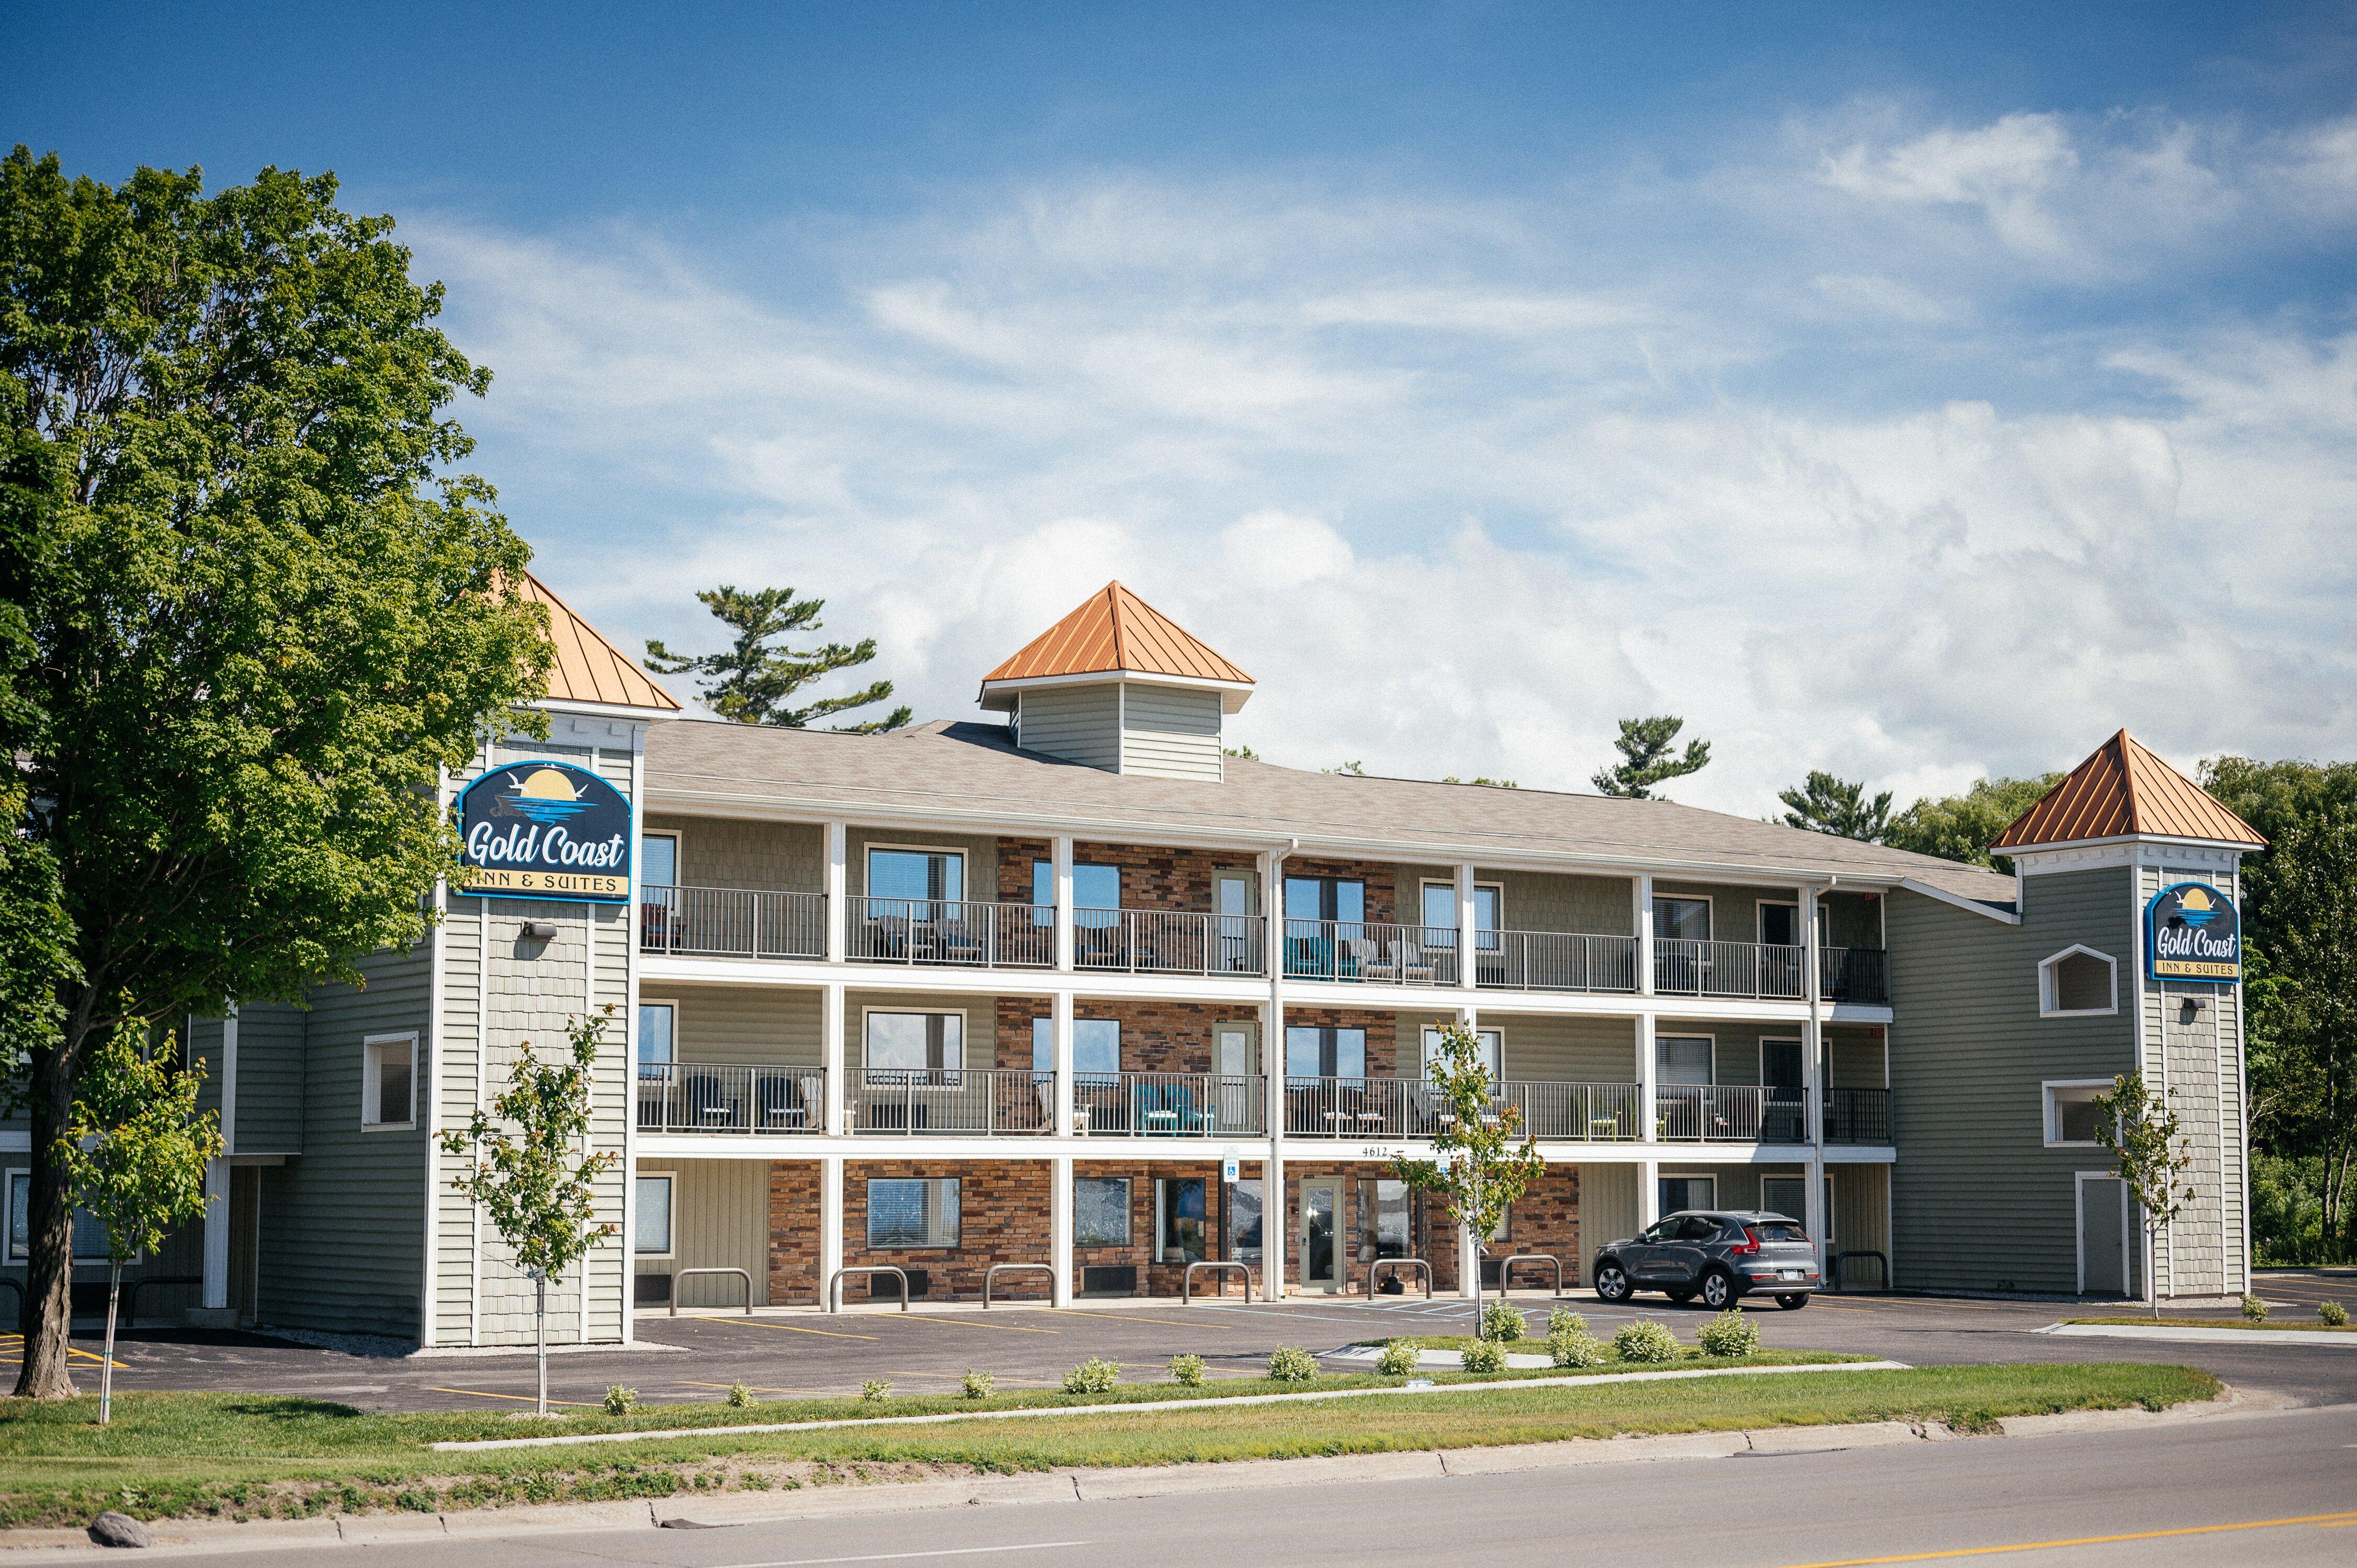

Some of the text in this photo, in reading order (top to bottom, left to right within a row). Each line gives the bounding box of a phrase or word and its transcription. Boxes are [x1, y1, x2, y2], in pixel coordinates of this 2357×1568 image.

[468, 821, 625, 867] Gold Coast
[522, 874, 534, 887] &
[544, 876, 616, 891] SUITES
[2157, 926, 2237, 959] Gold Coast
[2162, 962, 2233, 975] INN & SUITES
[1362, 1147, 1387, 1157] 4612
